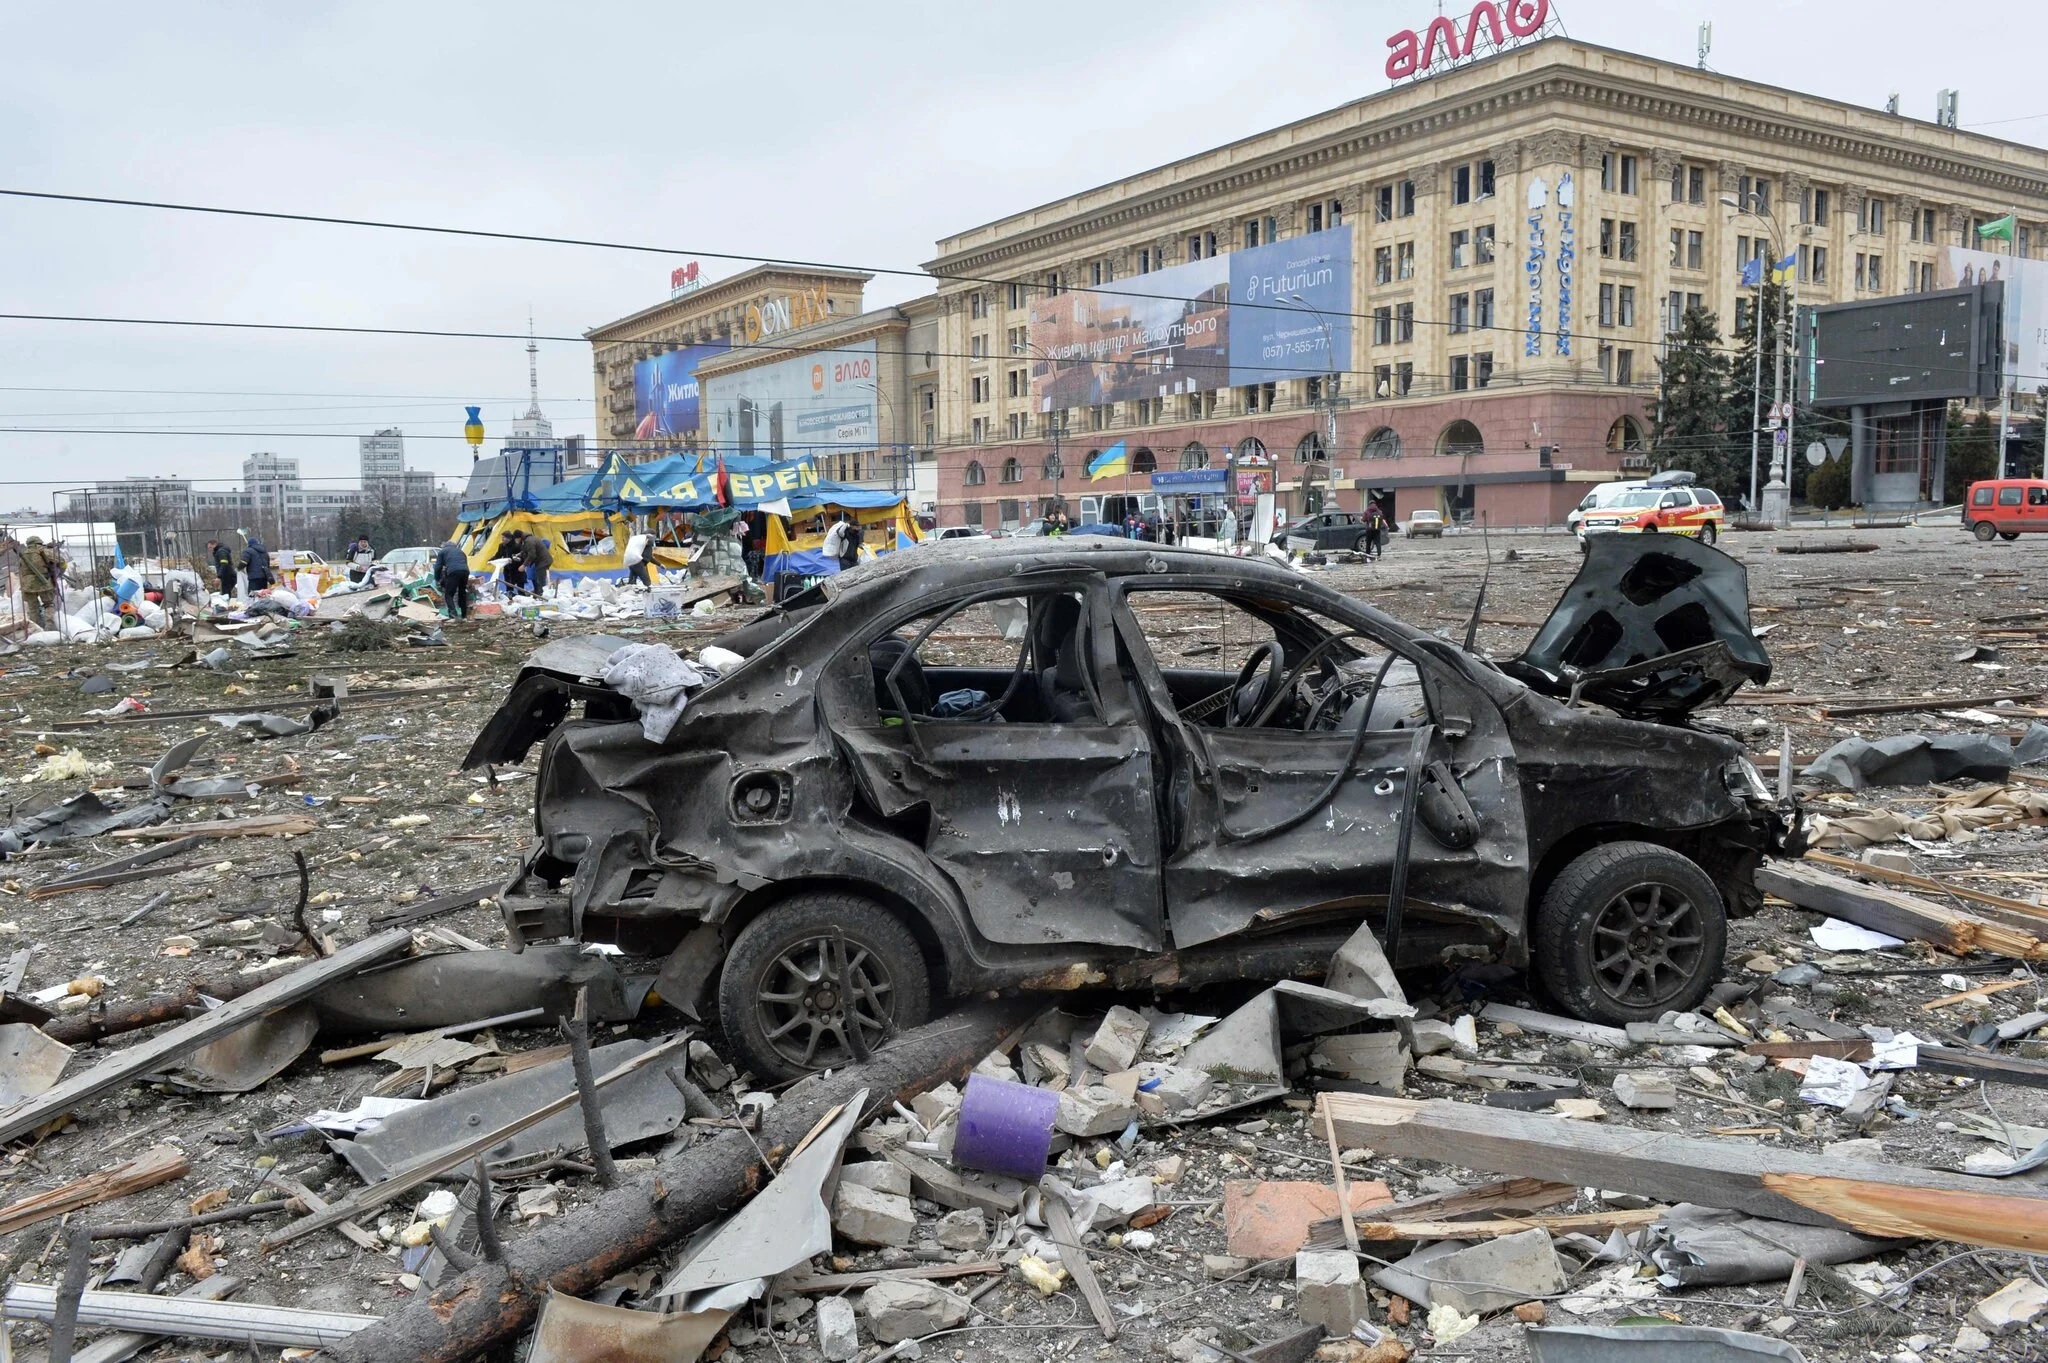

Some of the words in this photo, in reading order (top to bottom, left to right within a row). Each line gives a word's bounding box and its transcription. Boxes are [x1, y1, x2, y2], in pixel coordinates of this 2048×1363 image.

[1263, 268, 1332, 296] Futurium
[1046, 343, 1076, 360] Живи
[1132, 316, 1217, 345] майбутнього
[1262, 344, 1284, 360] (057)
[837, 427, 853, 439] Серія
